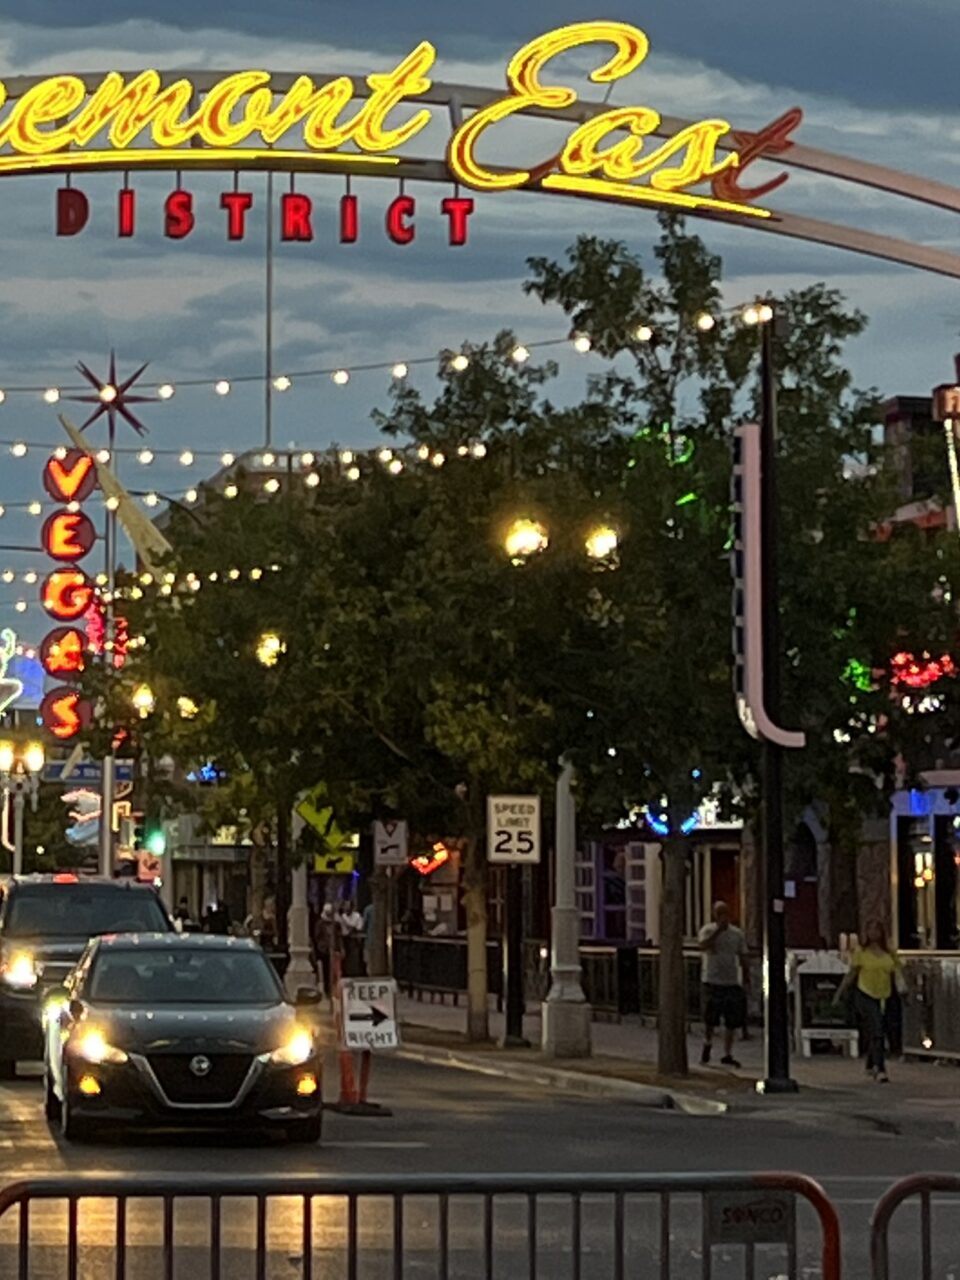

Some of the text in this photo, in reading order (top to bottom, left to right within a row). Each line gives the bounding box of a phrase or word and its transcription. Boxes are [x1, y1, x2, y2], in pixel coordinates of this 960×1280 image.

[445, 19, 804, 205] East
[56, 186, 474, 246] DISTRICT
[43, 452, 94, 740] VEGAS
[494, 802, 536, 816] SPEED
[494, 830, 534, 854] 25
[348, 1031, 393, 1045] RIGHT
